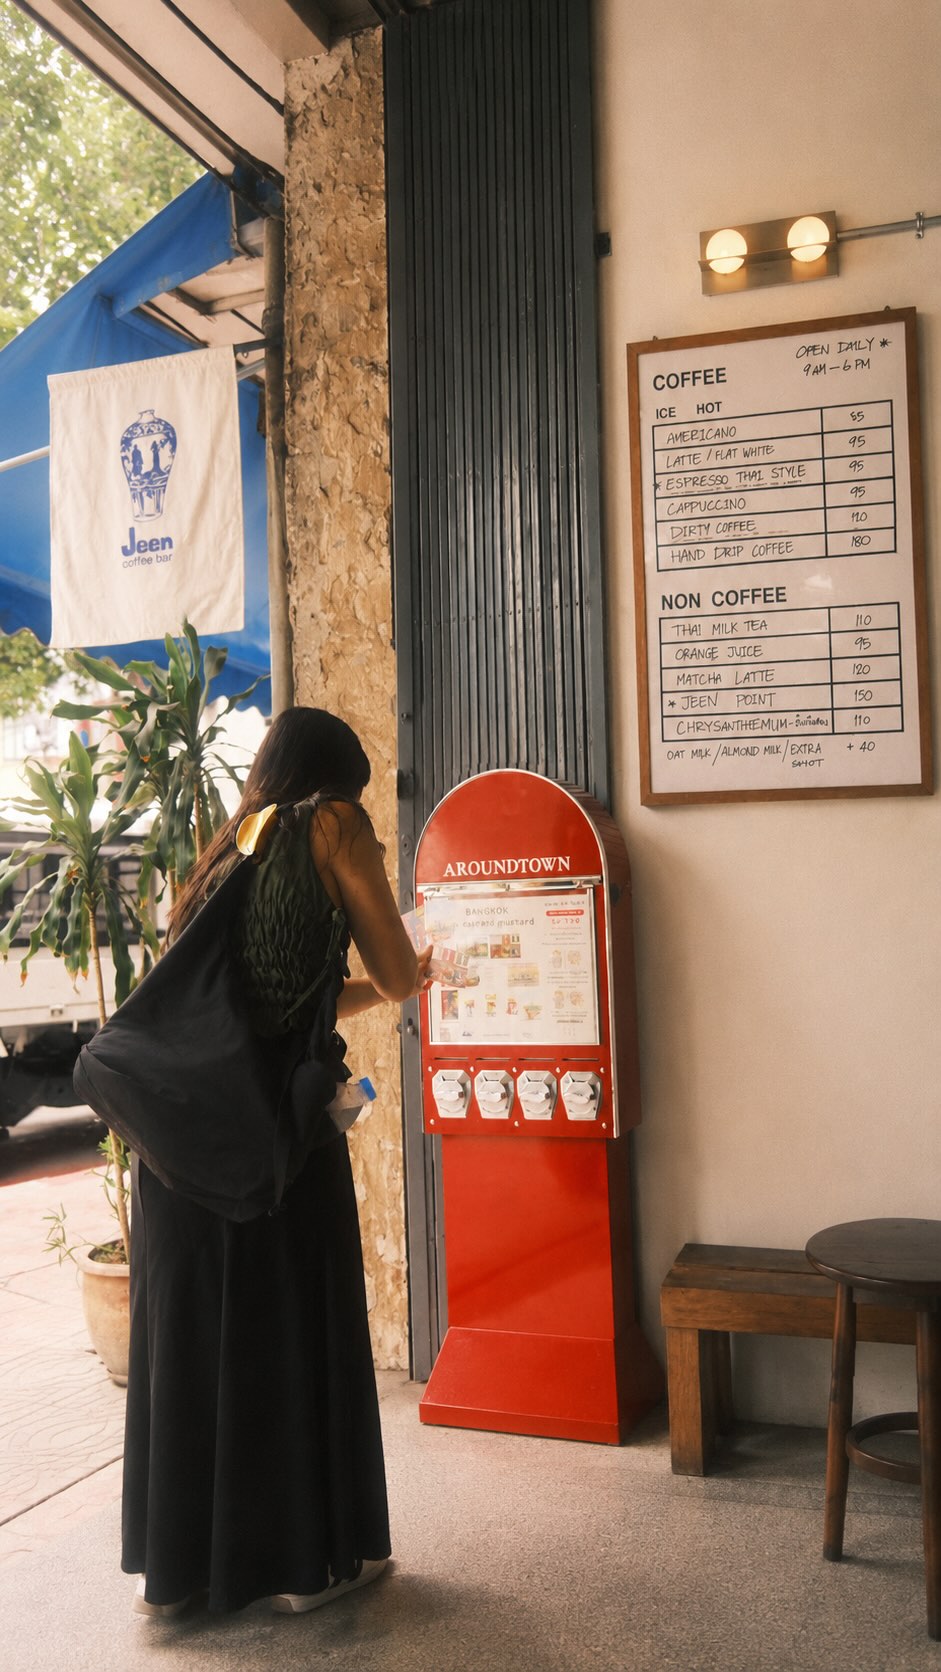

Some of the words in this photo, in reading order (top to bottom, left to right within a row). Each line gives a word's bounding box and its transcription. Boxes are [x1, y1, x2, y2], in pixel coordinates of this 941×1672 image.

[795, 343, 830, 359] OPEN
[837, 337, 875, 354] DAILY
[652, 367, 727, 391] COFFEE
[655, 406, 677, 420] ICE
[696, 401, 722, 415] HOT
[850, 411, 865, 422] 55
[666, 426, 737, 444] AMERICANO
[848, 435, 866, 448] 95
[666, 452, 702, 469] LATTE
[715, 448, 739, 461] FLAT
[742, 445, 775, 458] WHITE
[848, 460, 865, 473] 95
[665, 474, 729, 491] ESPRESSO
[736, 470, 764, 483] THAI
[770, 464, 806, 479] STYLE
[850, 486, 866, 498] 95
[667, 497, 746, 516] CAPPUCCINO
[670, 522, 711, 540] DIRTY
[715, 520, 757, 534] COFFEE
[121, 526, 174, 557] Jeen
[851, 535, 871, 548] 180
[671, 549, 706, 563] HAND
[714, 545, 744, 560] DRIP
[751, 541, 794, 558] COFFEE
[122, 556, 153, 569] coffee
[156, 553, 173, 564] bar
[661, 592, 701, 611] NON
[711, 586, 787, 607] COFFEE
[671, 623, 702, 637] THAI
[711, 622, 739, 635] MILK
[744, 619, 768, 632] TEA
[855, 614, 872, 627] 110
[854, 636, 872, 650] 95
[675, 647, 719, 662] ORANGE
[727, 645, 764, 658] JUICE
[676, 673, 722, 686] MATCHA
[734, 669, 775, 685] LATTE
[852, 663, 871, 675] 120
[681, 691, 719, 710] JEEN
[736, 692, 776, 708] POINT
[854, 689, 873, 702] 150
[854, 714, 871, 727] 110
[666, 750, 685, 761] OAT
[690, 749, 712, 759] MILK
[859, 741, 876, 752] 40
[443, 856, 571, 877] AROUNDTOWN
[465, 906, 509, 916] BANGKOK
